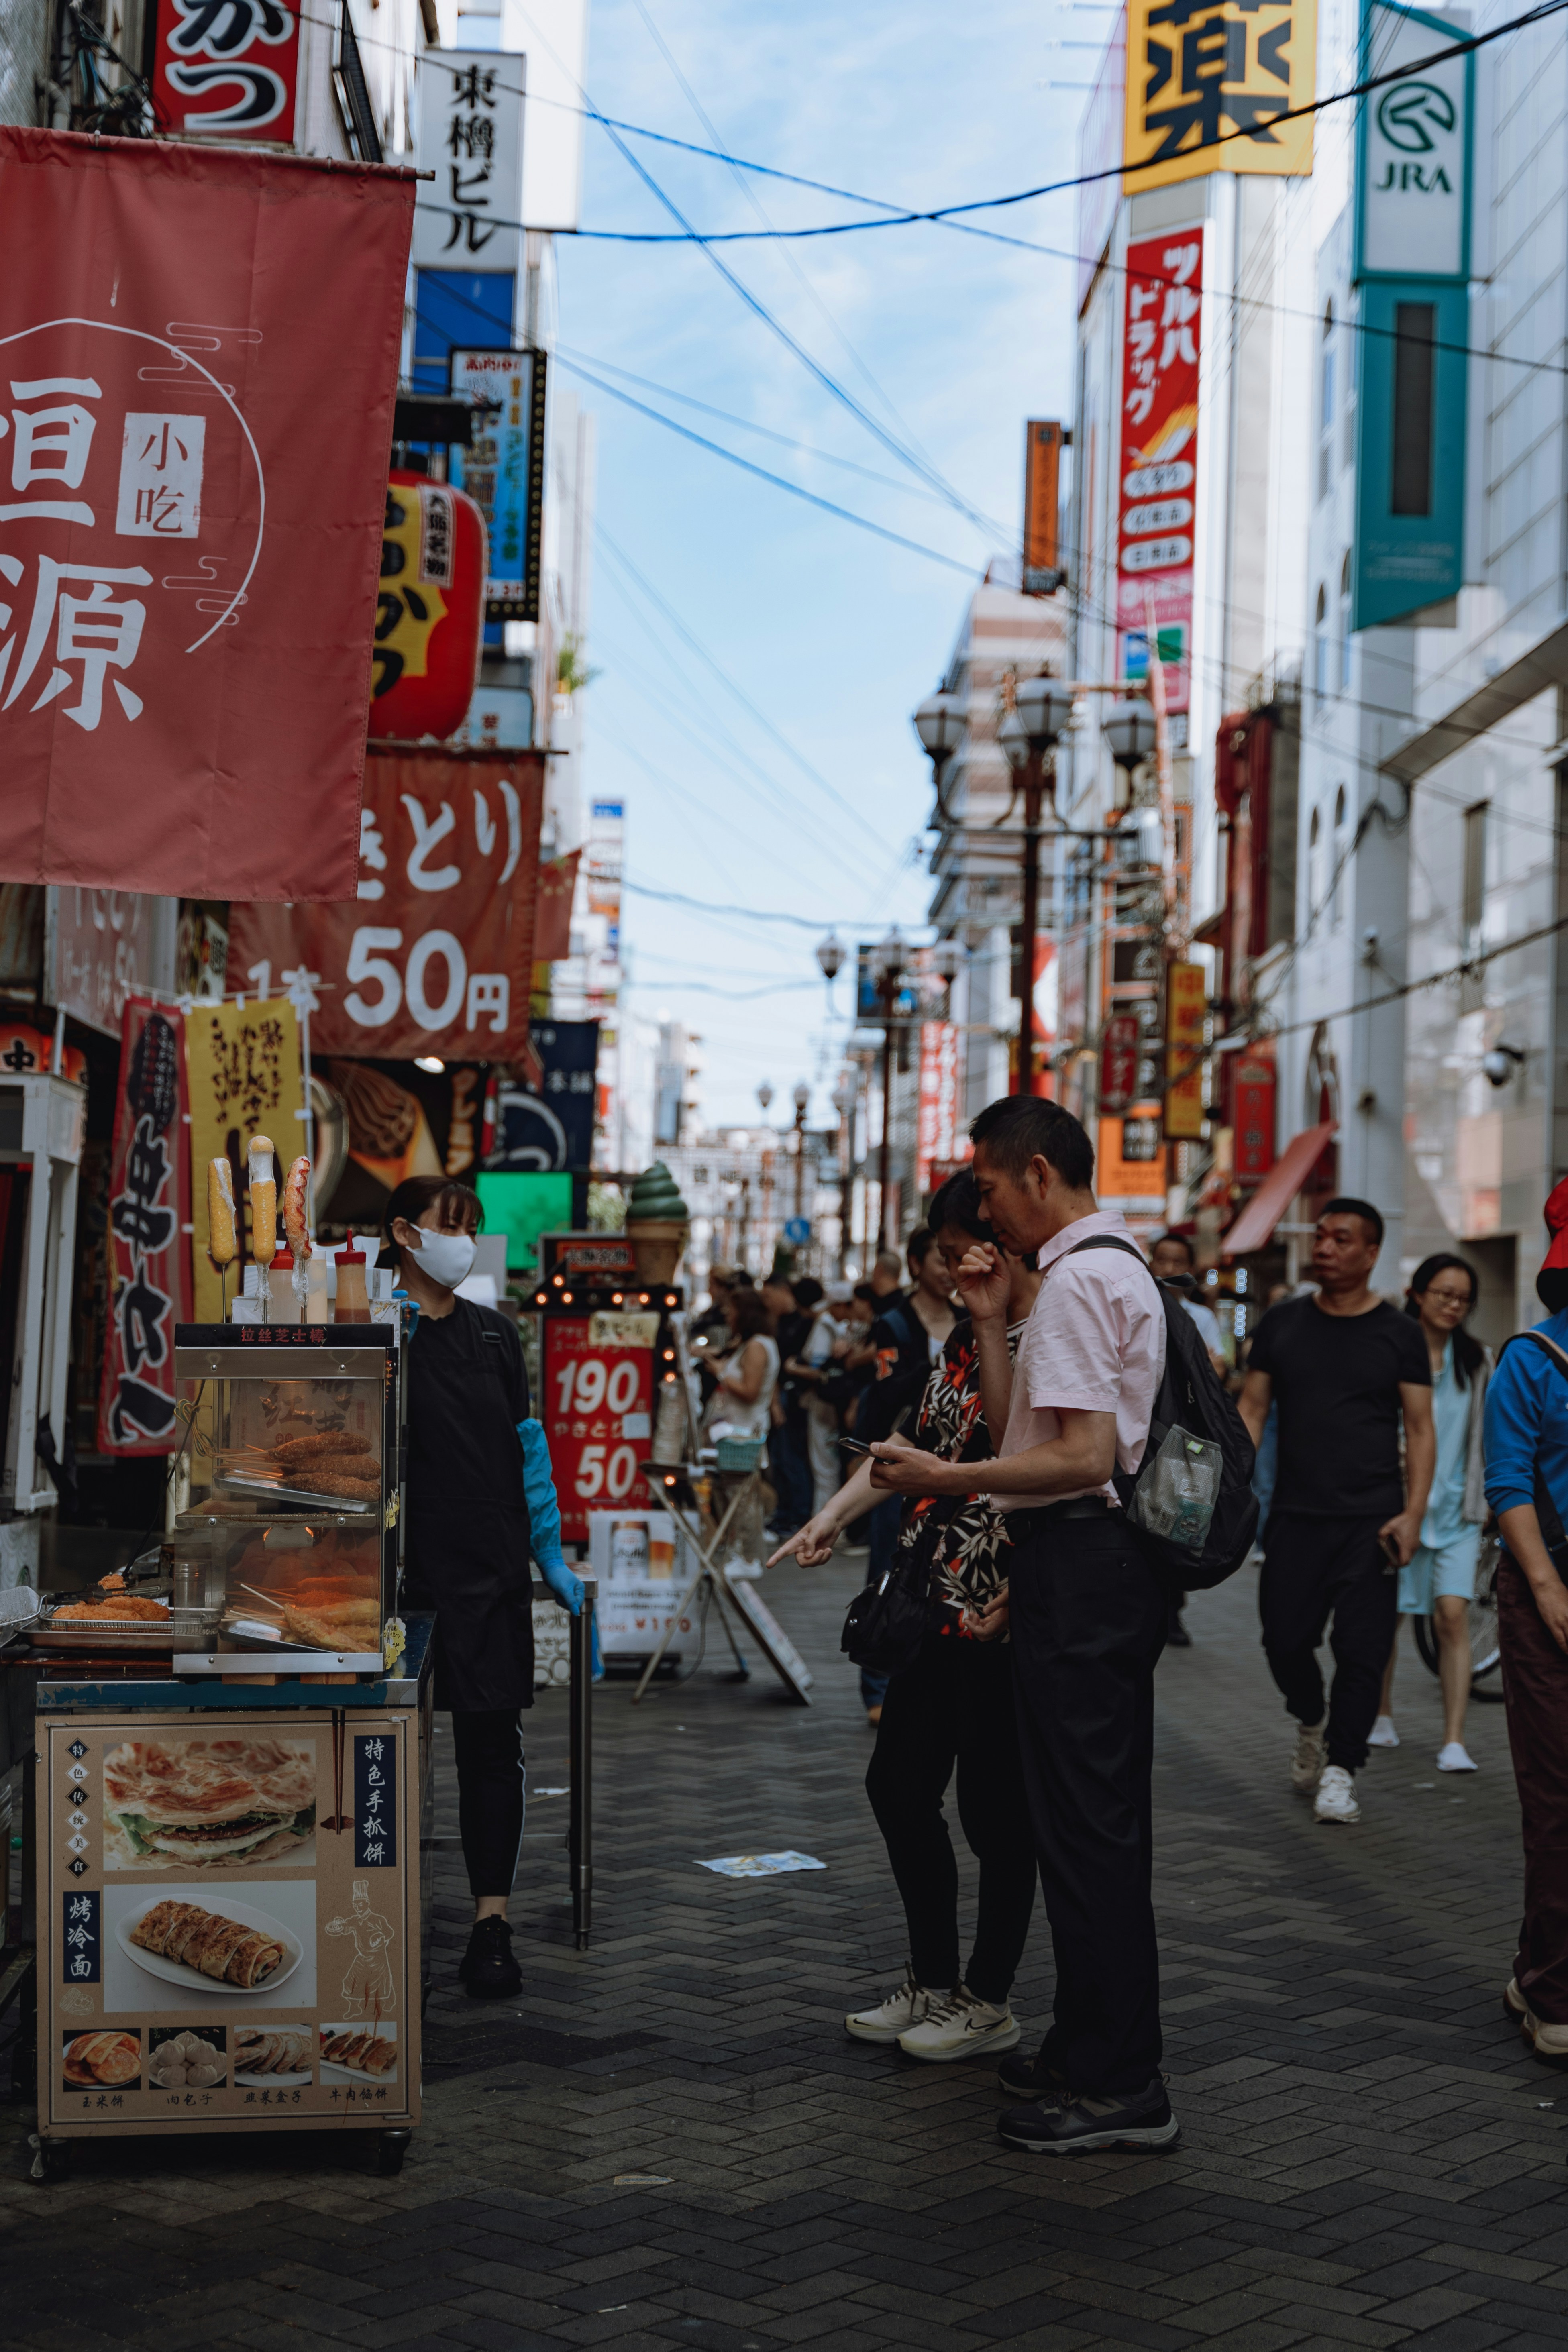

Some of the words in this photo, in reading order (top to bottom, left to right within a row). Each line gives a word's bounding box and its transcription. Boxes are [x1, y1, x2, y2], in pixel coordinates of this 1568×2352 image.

[1376, 161, 1452, 193] JRA
[1160, 241, 1201, 369] ツルハ
[1126, 278, 1163, 427] ドラッグ
[137, 422, 188, 533] 小吃
[343, 926, 510, 1033] 50円
[241, 1328, 324, 1342] 拉丝芝士棒
[72, 1745, 84, 1872] 特色传统美食
[363, 1738, 388, 1865] 特色手抓饼
[67, 1896, 95, 1977] 烤冷面
[82, 2094, 124, 2109] 玉米饼
[167, 2093, 213, 2106] 肉包子
[244, 2089, 302, 2105] 韭菜盒子
[329, 2087, 389, 2103] 牛肉馅饼
